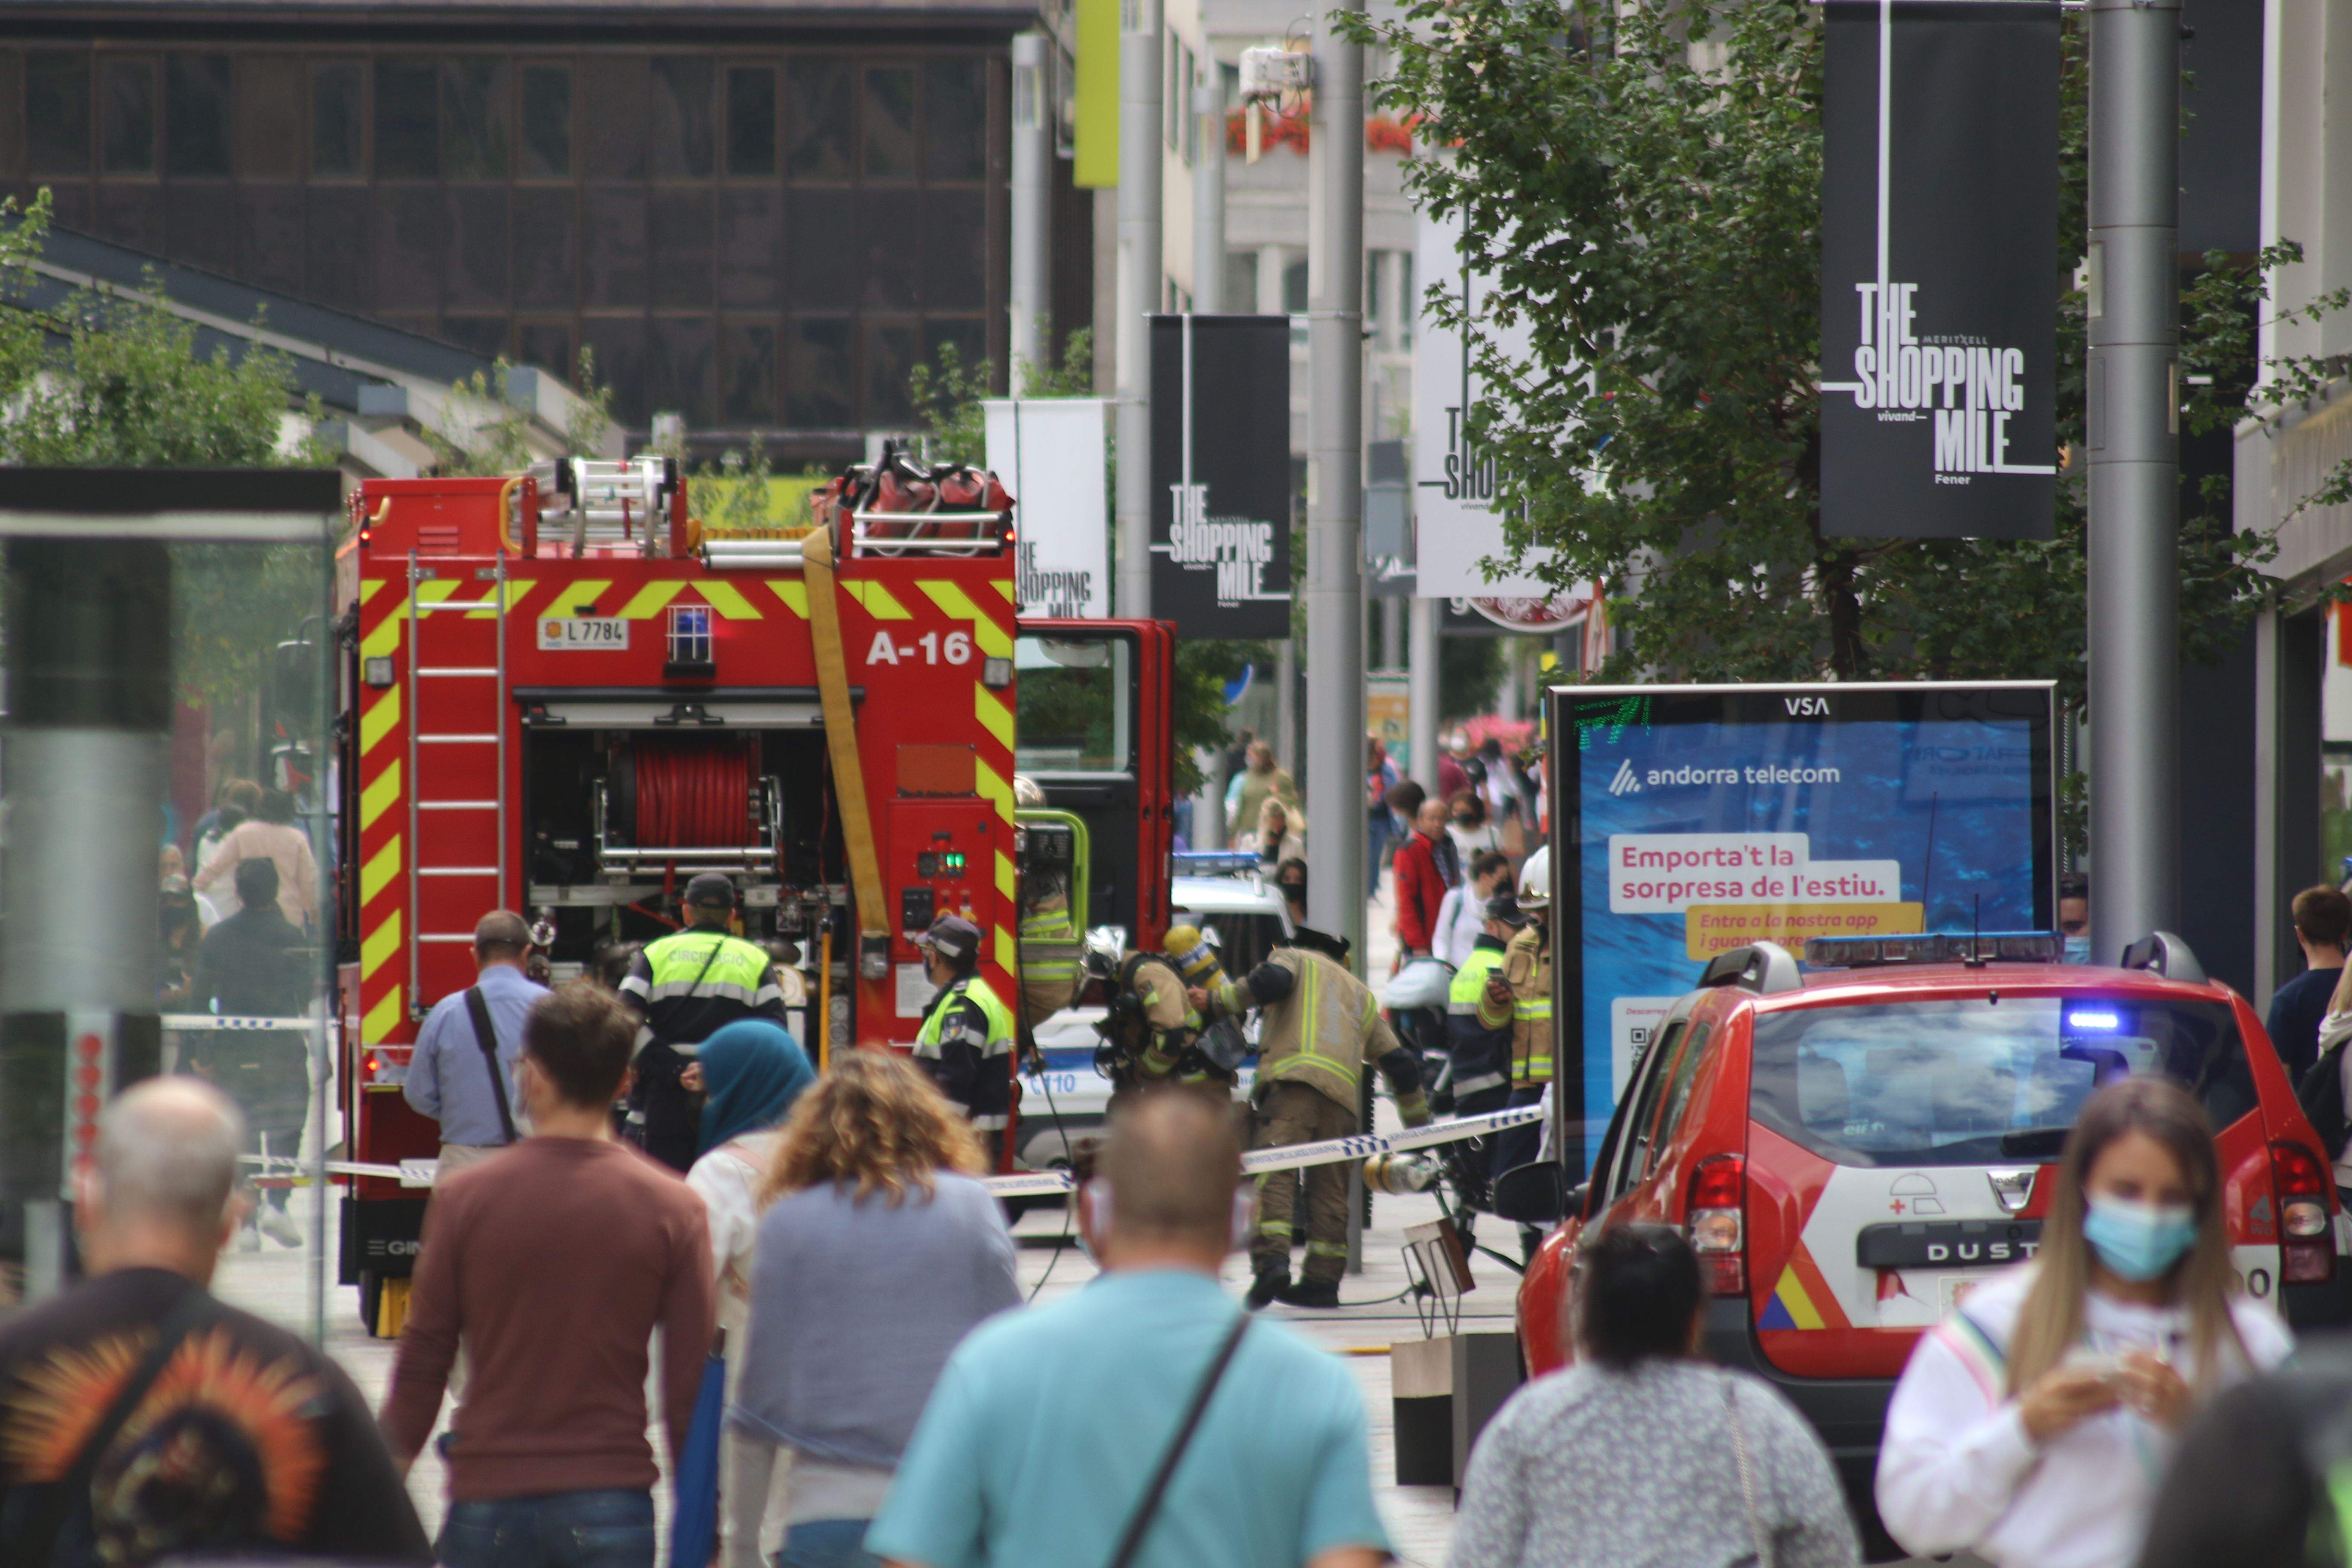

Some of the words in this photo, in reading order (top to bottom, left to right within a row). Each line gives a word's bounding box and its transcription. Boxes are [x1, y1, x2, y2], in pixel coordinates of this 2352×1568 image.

[1855, 283, 1918, 346] THE
[1923, 335, 1988, 346] MERITXELL
[1854, 345, 2024, 411] SHOPPING
[1935, 409, 2012, 473] MILE
[1935, 474, 1971, 485] Fener
[1169, 484, 1207, 523] THE
[1169, 523, 1272, 563] SHOPPING
[1017, 572, 1091, 602] HOPPING
[1216, 561, 1264, 600] MILE
[568, 622, 576, 640] L
[582, 622, 622, 641] 7784
[865, 631, 971, 666] A-16
[1646, 765, 1739, 785] andorra
[1744, 764, 1841, 784] telecom
[1622, 845, 1763, 873] Emporta't
[1770, 845, 1794, 866] la
[1622, 880, 1743, 903] sorpresa
[1751, 876, 1785, 897] de
[1792, 873, 1885, 897] l'estiu.
[1700, 914, 1747, 928] Entra
[1751, 916, 1762, 928] a
[1765, 913, 1781, 928] la
[1786, 914, 1841, 928] nostra
[1845, 914, 1877, 929] app
[1700, 933, 1706, 947] i
[2250, 1194, 2272, 1223] 4
[1927, 1241, 2040, 1261] DUST
